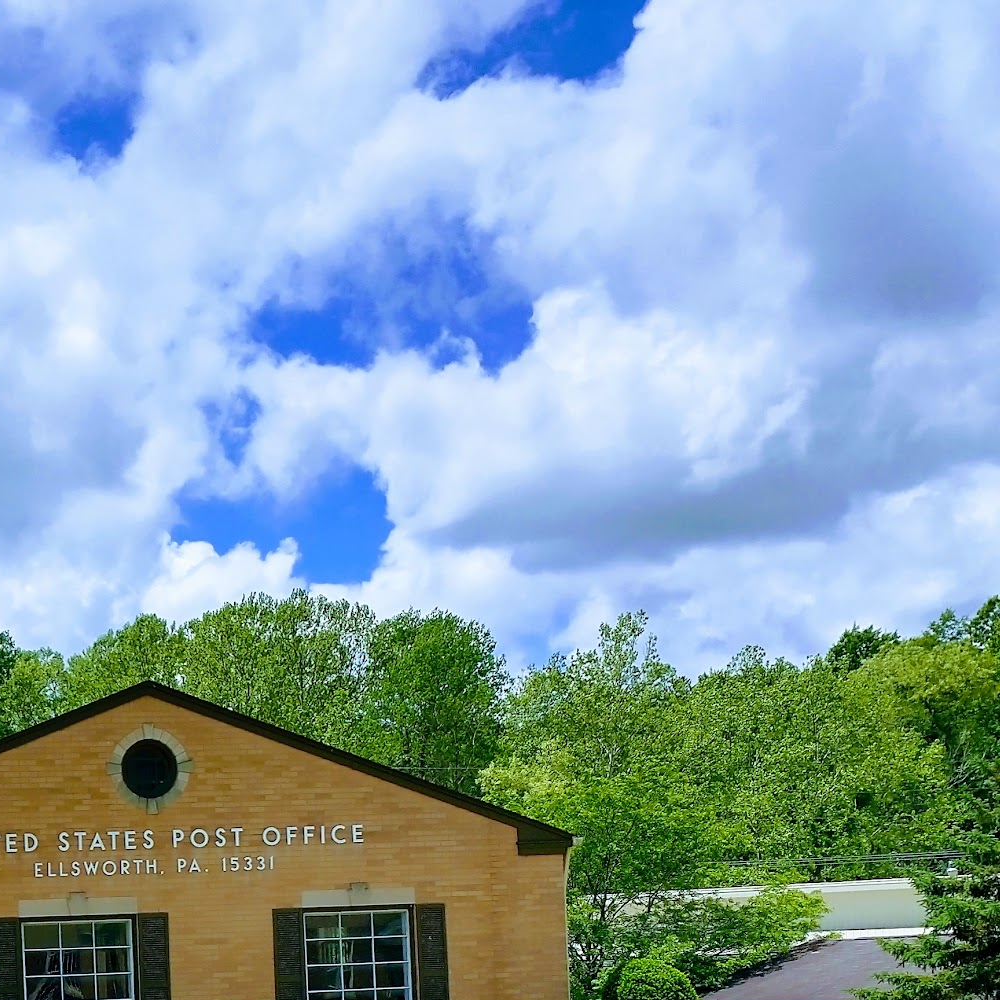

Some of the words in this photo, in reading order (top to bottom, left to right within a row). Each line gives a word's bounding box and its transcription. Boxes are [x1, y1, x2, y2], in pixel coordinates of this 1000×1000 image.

[58, 829, 155, 852] STATES
[172, 827, 244, 848] POST
[262, 824, 365, 845] OFFICE
[34, 859, 165, 878] ELLSWORTH,
[177, 858, 209, 873] PA.
[222, 855, 275, 872] 15331
